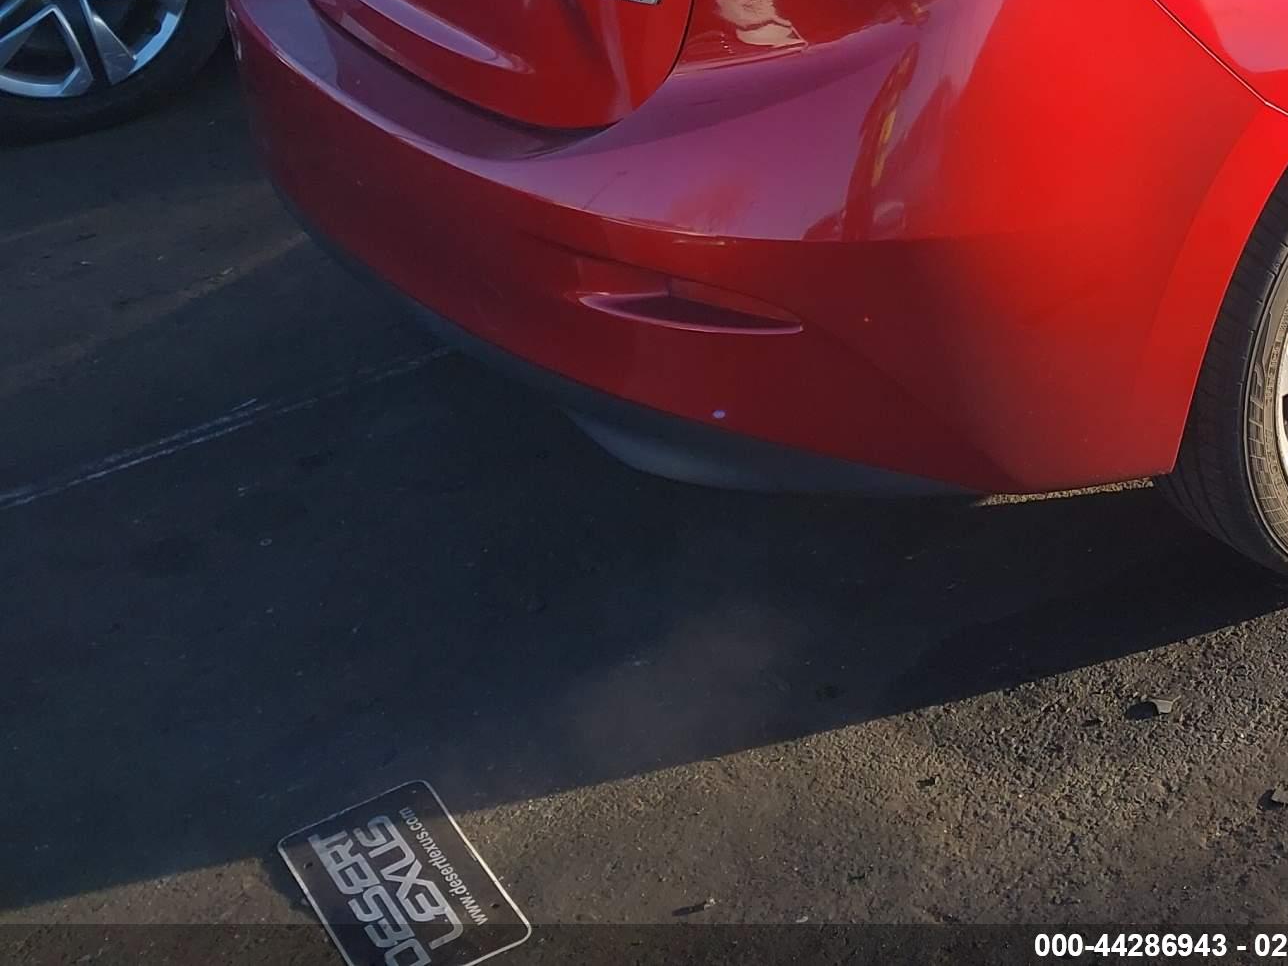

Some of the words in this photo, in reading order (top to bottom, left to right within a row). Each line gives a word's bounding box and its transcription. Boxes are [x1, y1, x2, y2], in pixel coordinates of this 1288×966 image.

[307, 830, 432, 966] DESERT
[353, 815, 464, 950] LEXUS
[399, 806, 488, 927] www.desertlexus.com
